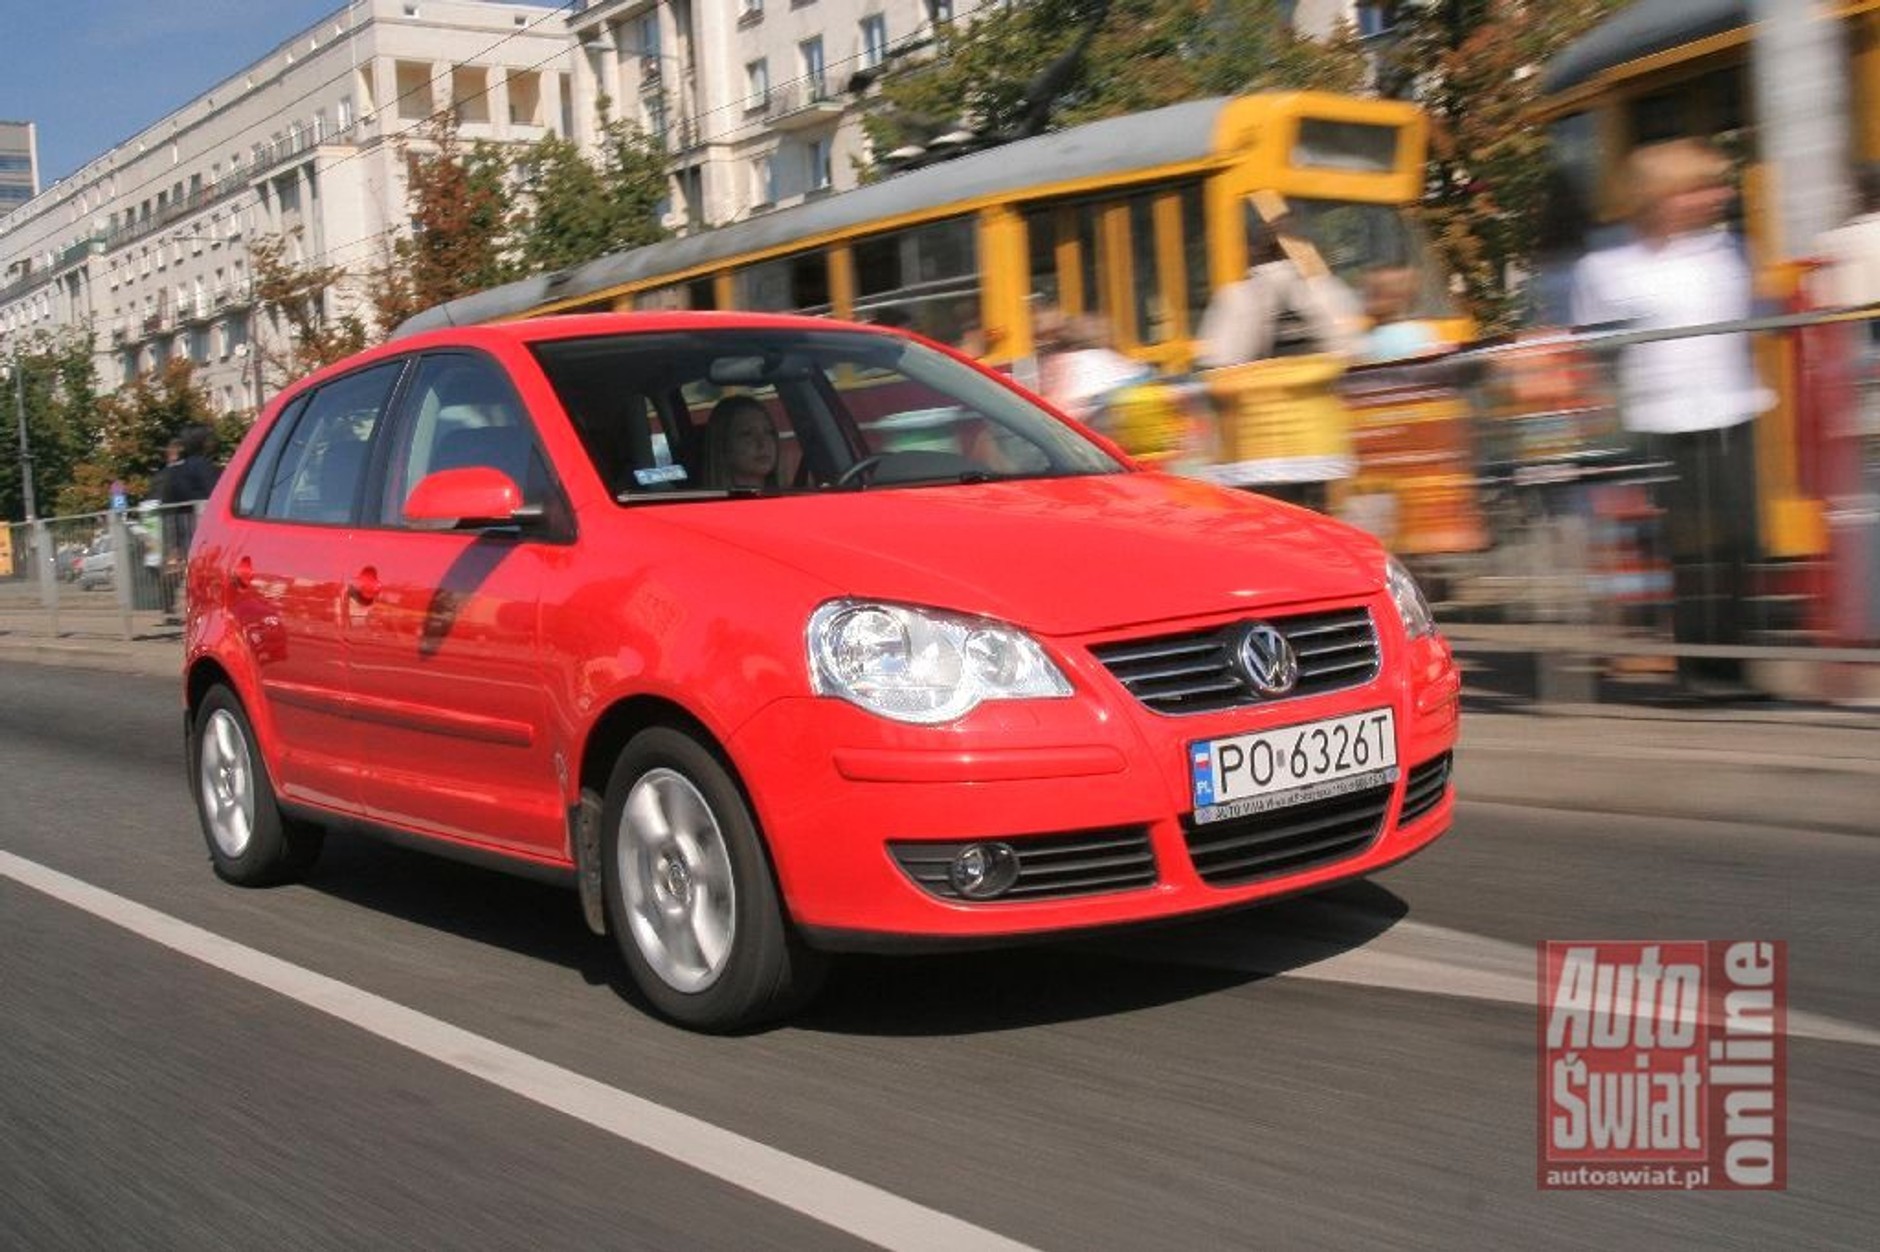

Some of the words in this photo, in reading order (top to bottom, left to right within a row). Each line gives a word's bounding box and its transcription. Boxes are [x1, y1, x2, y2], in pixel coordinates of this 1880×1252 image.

[1217, 740, 1274, 794] PO
[1290, 714, 1388, 778] 6326T
[1197, 781, 1212, 795] PL
